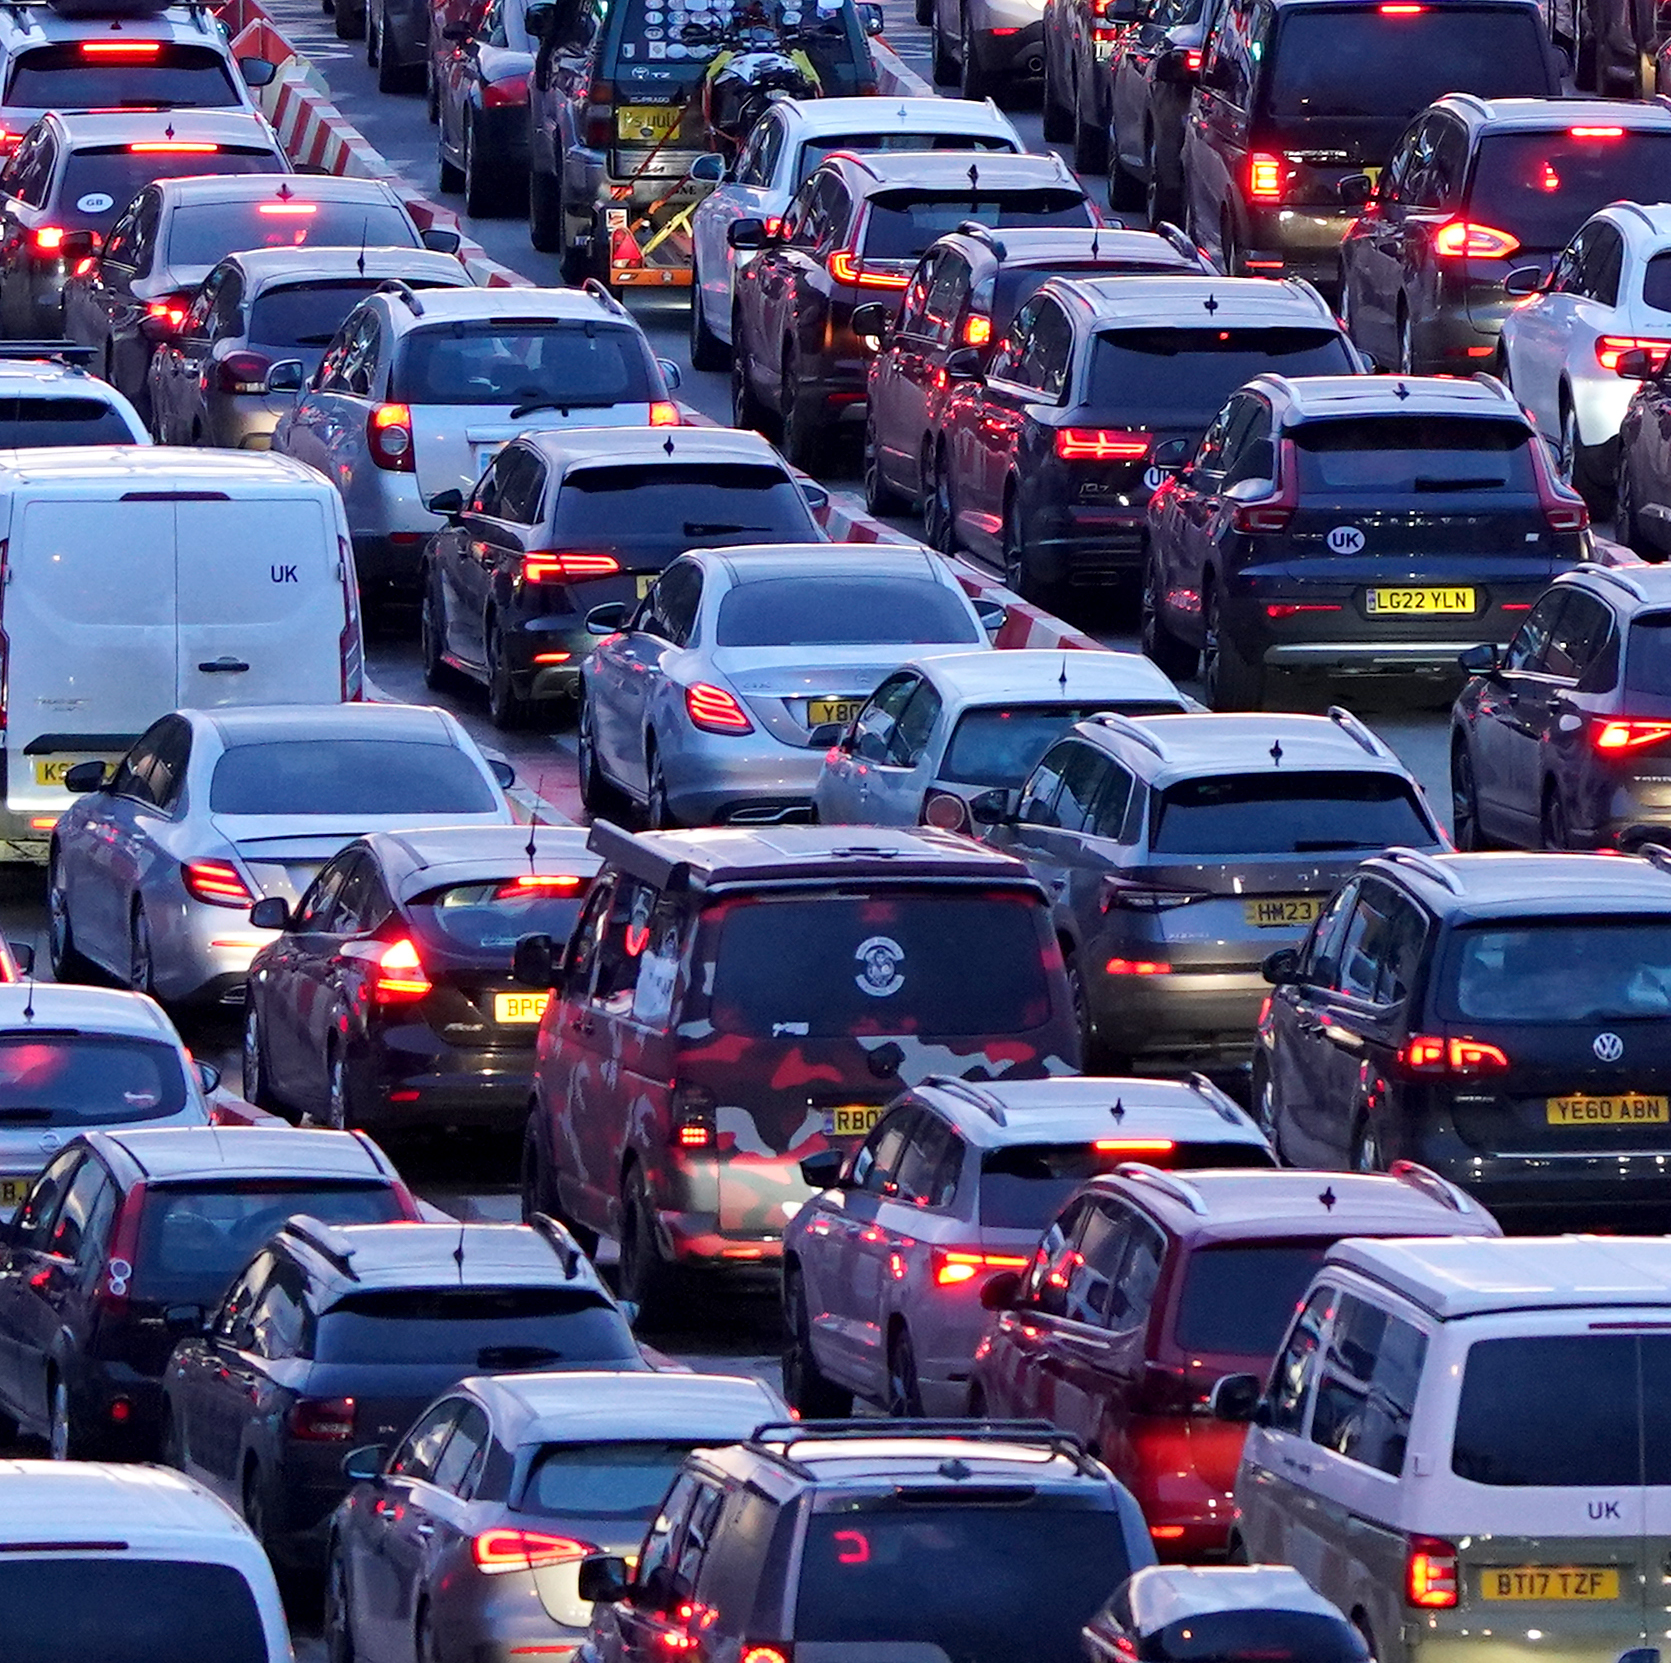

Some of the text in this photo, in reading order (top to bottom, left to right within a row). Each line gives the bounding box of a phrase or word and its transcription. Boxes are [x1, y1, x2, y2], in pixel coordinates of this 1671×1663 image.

[86, 198, 103, 207] GB
[1333, 532, 1360, 548] UK
[271, 565, 298, 583] UK
[1377, 591, 1466, 609] LG22 YLN
[1257, 903, 1312, 922] HM23
[1557, 1099, 1661, 1121] YE60 ABN
[1588, 1501, 1621, 1520] UK
[1497, 1574, 1603, 1597] BT17 TZF
